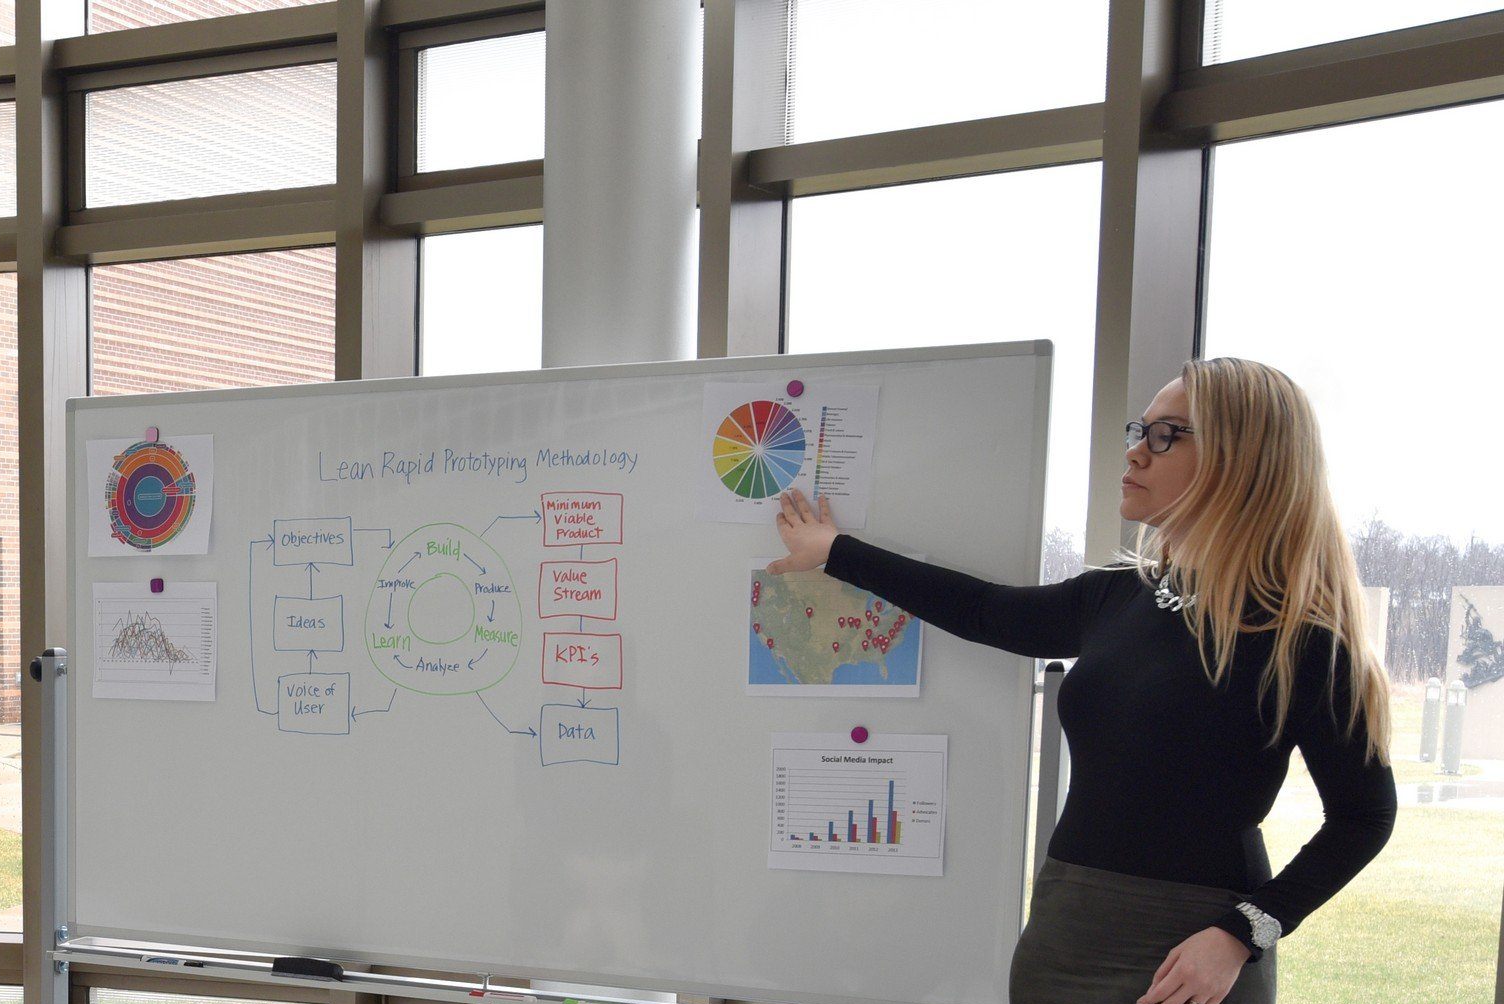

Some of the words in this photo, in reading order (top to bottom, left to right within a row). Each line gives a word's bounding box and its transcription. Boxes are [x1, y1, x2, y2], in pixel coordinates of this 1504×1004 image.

[319, 451, 374, 482] Lean
[381, 451, 435, 485] Rapid
[444, 448, 528, 484] Prototyping
[535, 448, 639, 474] Methodology
[546, 498, 602, 510] Minimum
[281, 528, 345, 547] Objectives
[556, 526, 604, 540] Product
[426, 537, 461, 562] Build
[552, 568, 588, 584] Value
[377, 578, 416, 593] Improve
[474, 582, 512, 595] Produce
[553, 586, 602, 602] Stream
[286, 614, 326, 630] Ideas
[372, 632, 411, 652] Learn
[474, 625, 519, 648] Measure
[555, 644, 600, 667] KPI's
[415, 656, 460, 677] Analyze
[286, 681, 320, 698] Voice
[324, 682, 336, 697] of
[294, 701, 325, 715] User
[558, 722, 596, 740] Data
[821, 755, 842, 763] Social
[843, 756, 866, 764] Media
[868, 757, 893, 765] Impact
